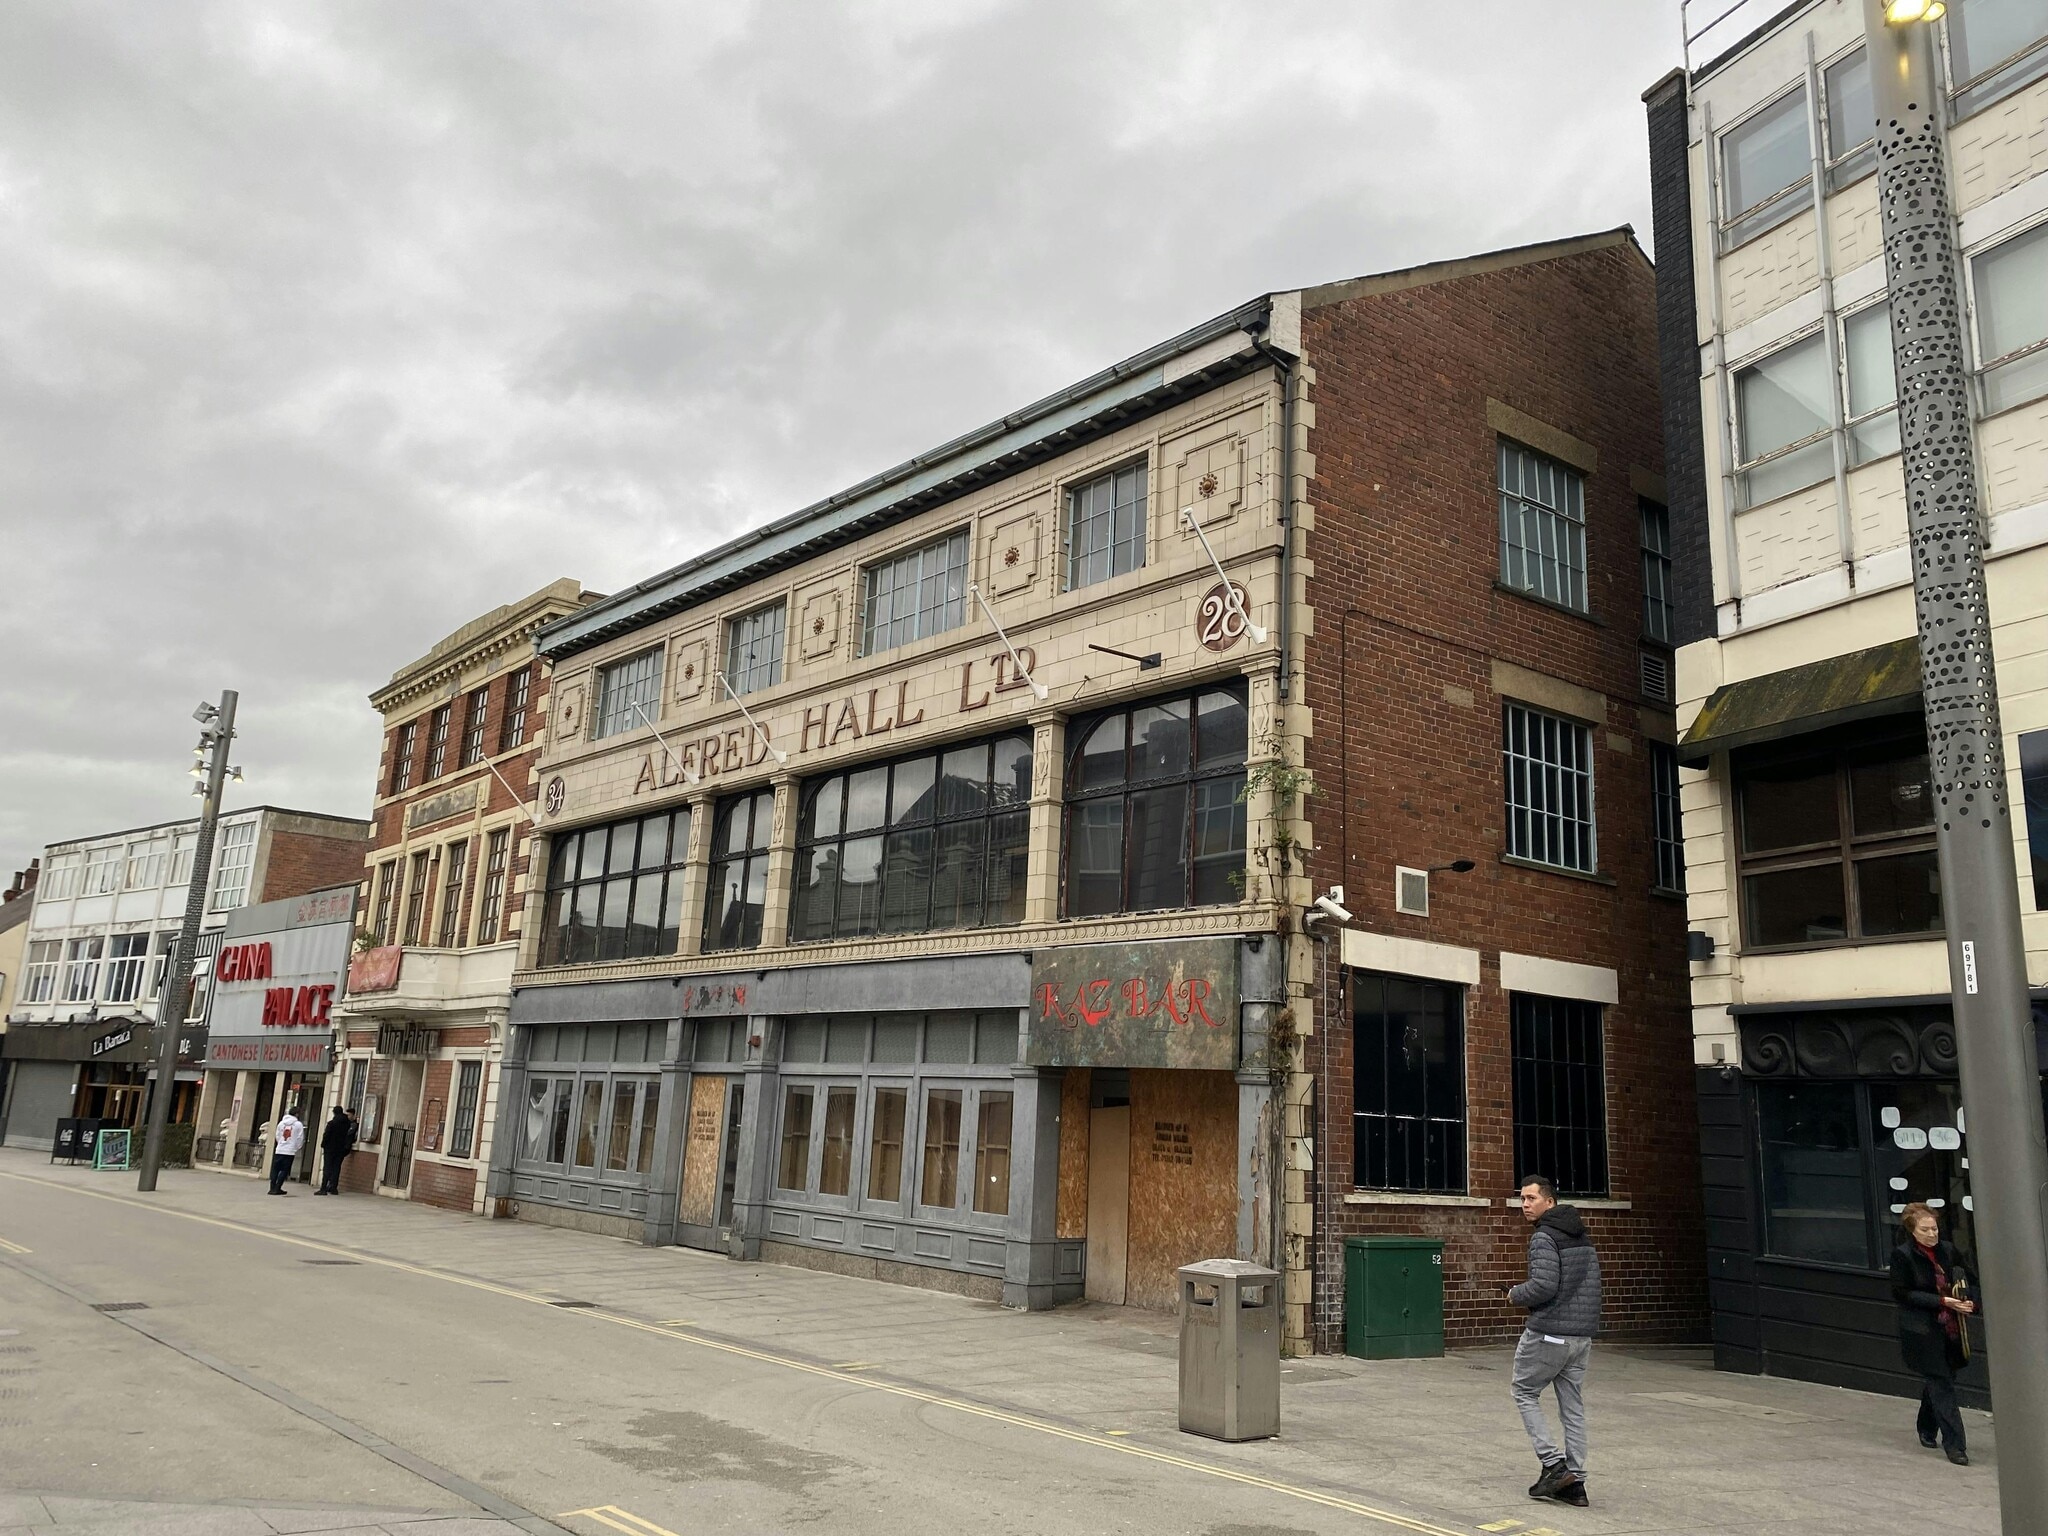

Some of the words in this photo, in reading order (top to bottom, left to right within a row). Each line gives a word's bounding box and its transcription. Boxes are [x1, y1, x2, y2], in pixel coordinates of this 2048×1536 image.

[1202, 588, 1246, 644] 28
[632, 721, 770, 794] ALFRED
[800, 680, 924, 753] HALL
[959, 646, 1037, 712] LTD
[547, 781, 564, 812] 34
[217, 942, 272, 982] CHINA
[1965, 944, 1973, 992] 69781
[262, 984, 335, 1027] PALACE
[1035, 978, 1112, 1028] KAZ
[1121, 977, 1226, 1028] BAR
[93, 1042, 103, 1055] La
[211, 1044, 259, 1061] CANTONESE
[263, 1043, 325, 1063] RESTAURANT
[1432, 1254, 1441, 1265] 52
